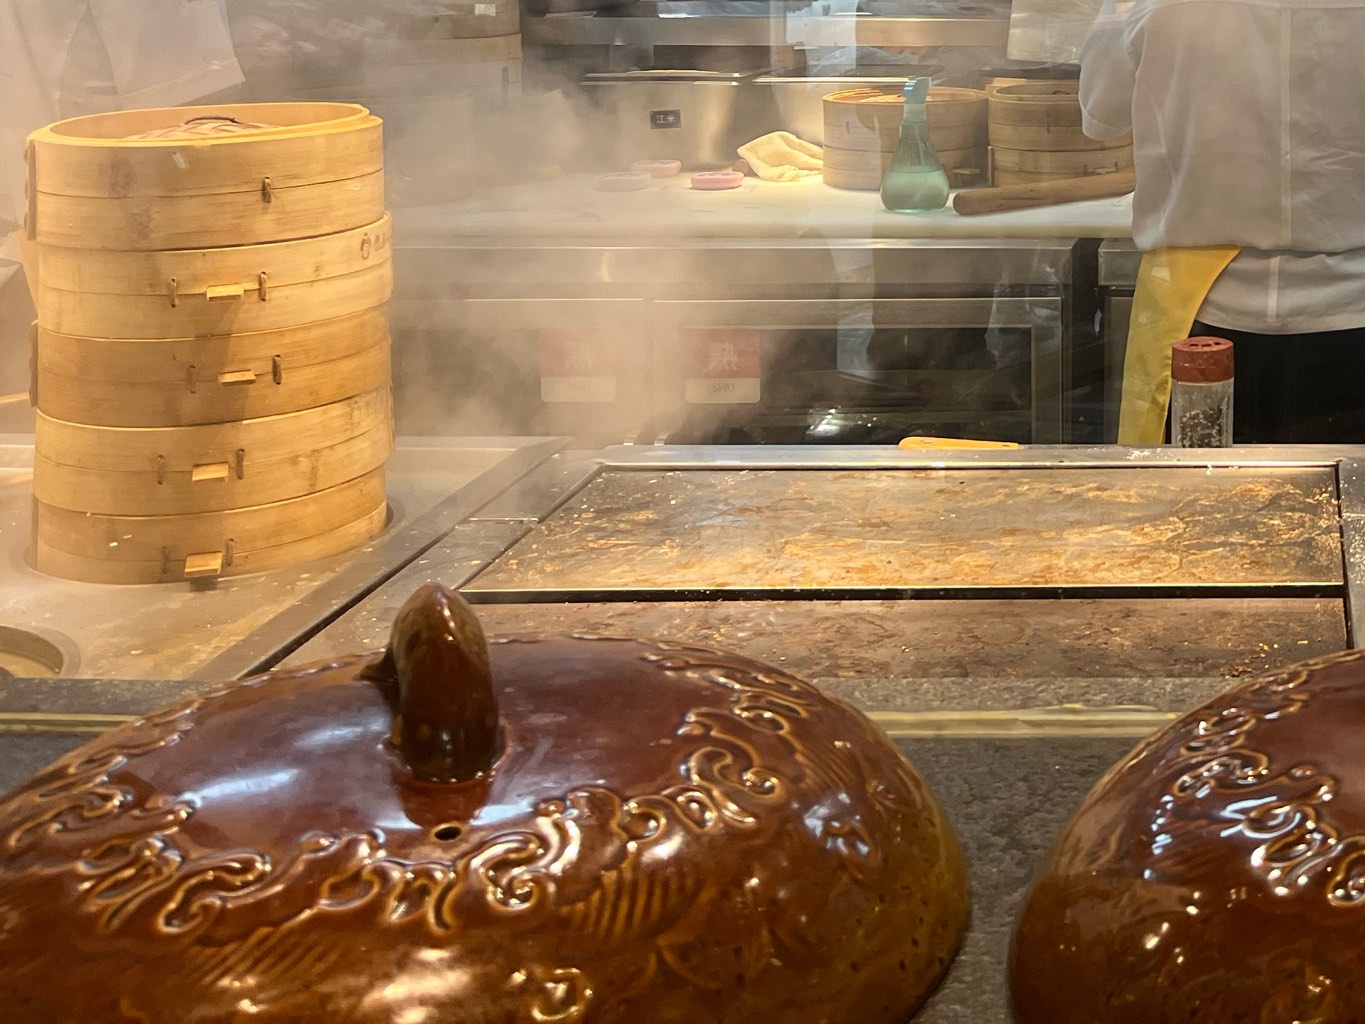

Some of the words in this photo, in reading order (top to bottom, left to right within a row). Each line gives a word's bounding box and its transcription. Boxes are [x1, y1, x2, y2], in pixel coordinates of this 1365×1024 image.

[655, 113, 677, 124] 江米
[704, 342, 738, 372] 熟
[711, 382, 736, 393] SHU
